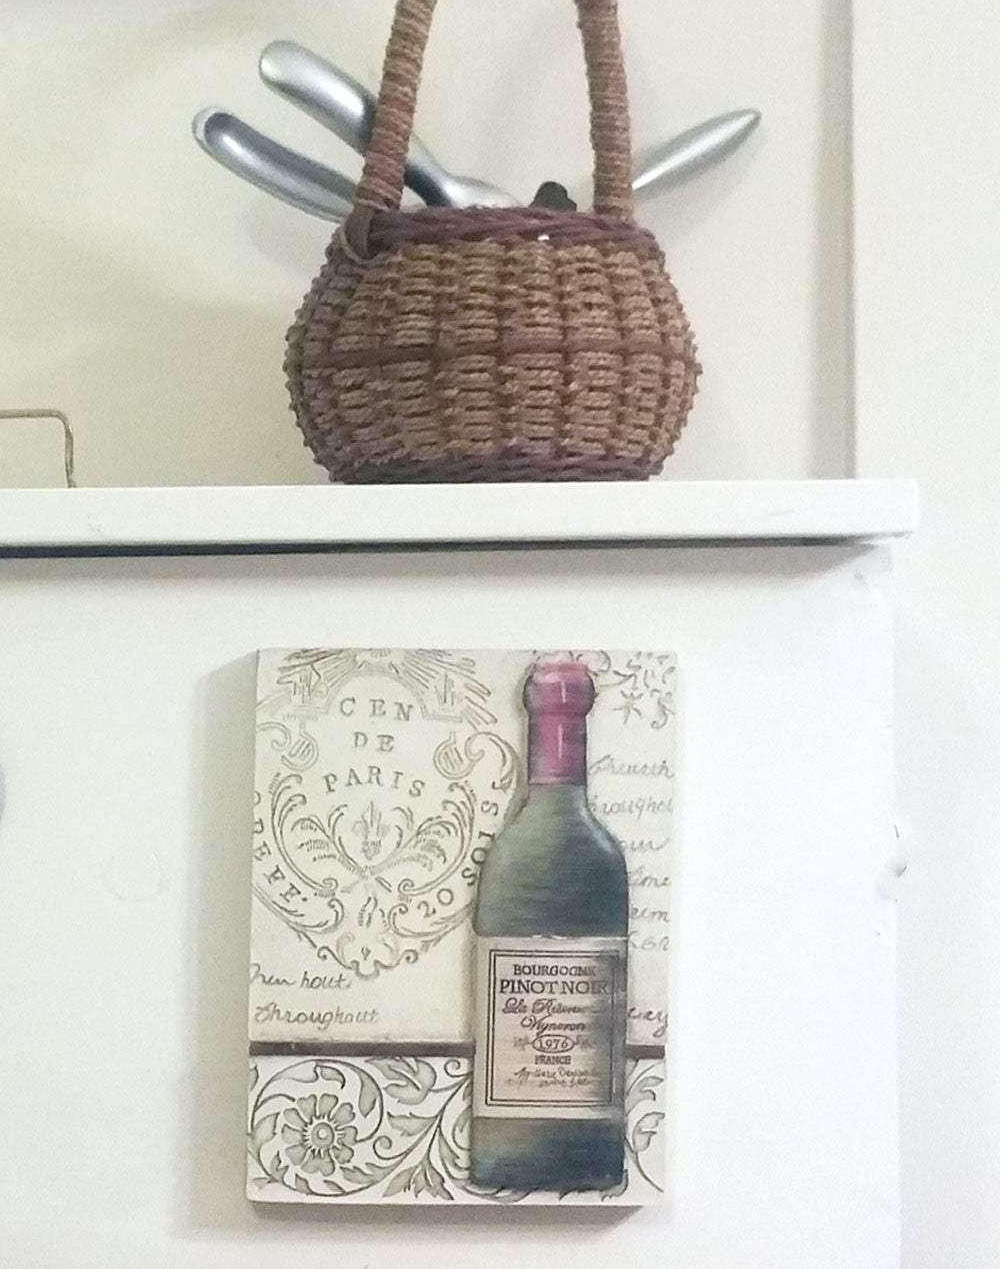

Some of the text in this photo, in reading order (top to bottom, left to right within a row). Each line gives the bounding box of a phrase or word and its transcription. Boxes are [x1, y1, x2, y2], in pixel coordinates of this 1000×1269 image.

[339, 697, 414, 722] CEN
[353, 731, 394, 752] DE
[323, 766, 425, 797] PARIS
[500, 979, 558, 995] PINOT
[538, 1038, 569, 1050] 1976
[535, 1055, 572, 1065] FRANCE
